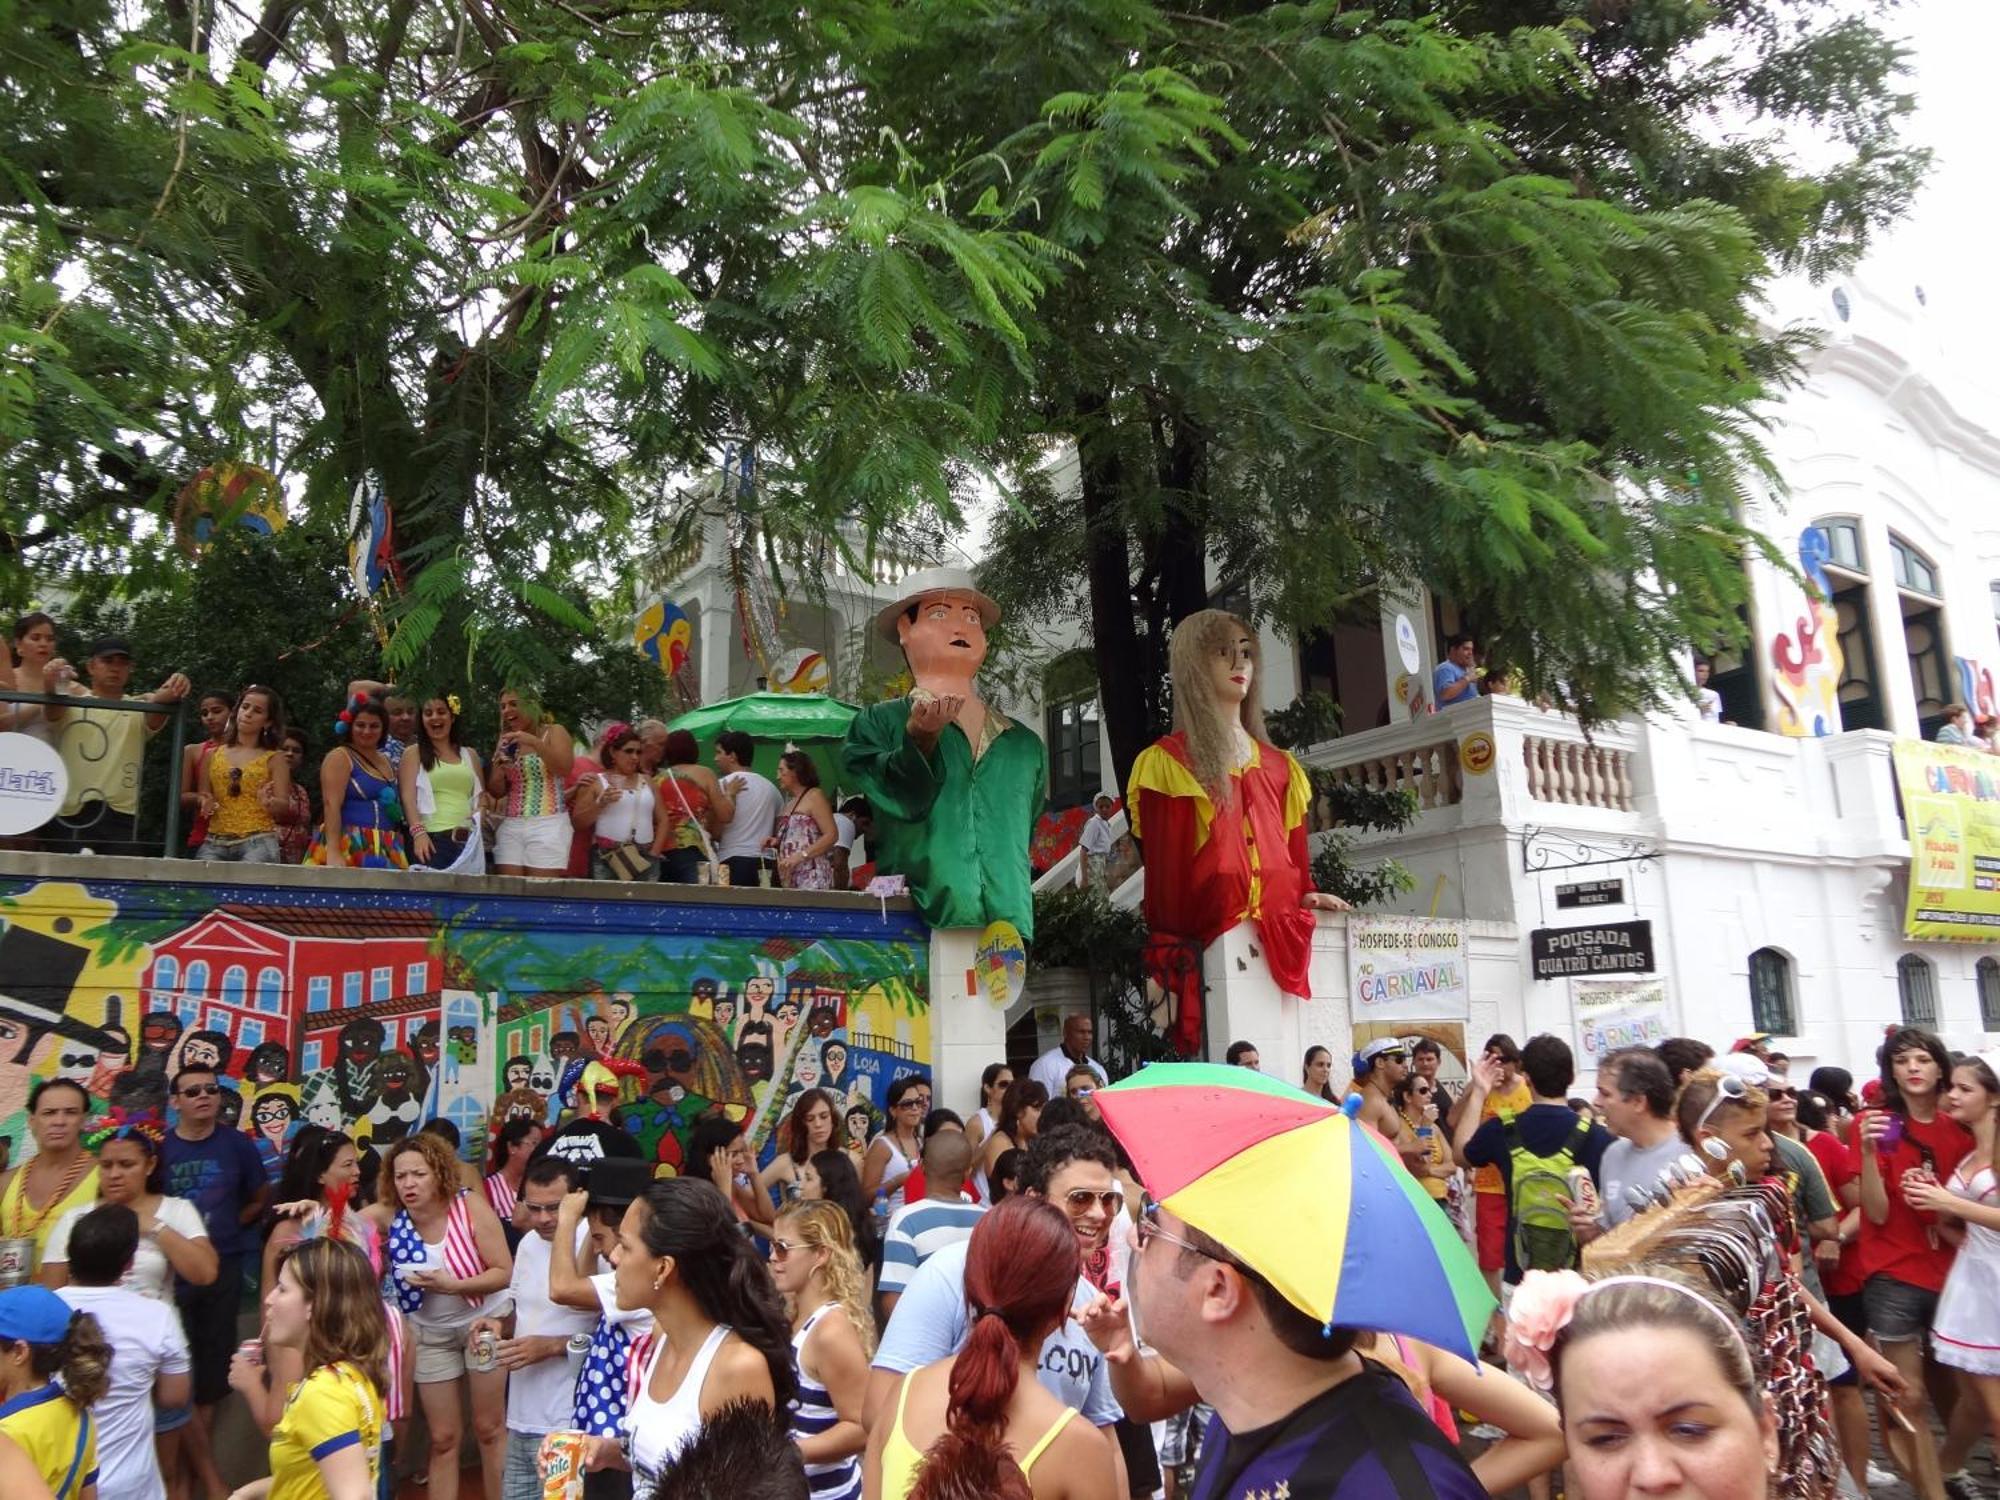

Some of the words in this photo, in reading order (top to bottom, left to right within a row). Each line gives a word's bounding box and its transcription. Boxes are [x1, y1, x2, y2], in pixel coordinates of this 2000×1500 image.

[1359, 933, 1413, 949] HOSPEDE-SE
[1418, 932, 1458, 948] CONOSCO
[1547, 930, 1632, 953] POUSADA
[1575, 946, 1602, 955] DOS
[1357, 963, 1374, 976] NO
[1539, 957, 1588, 974] QUATRO
[1591, 952, 1645, 970] CANTOS
[1359, 963, 1463, 1001] CARNAVAL
[854, 1053, 880, 1074] LOJA
